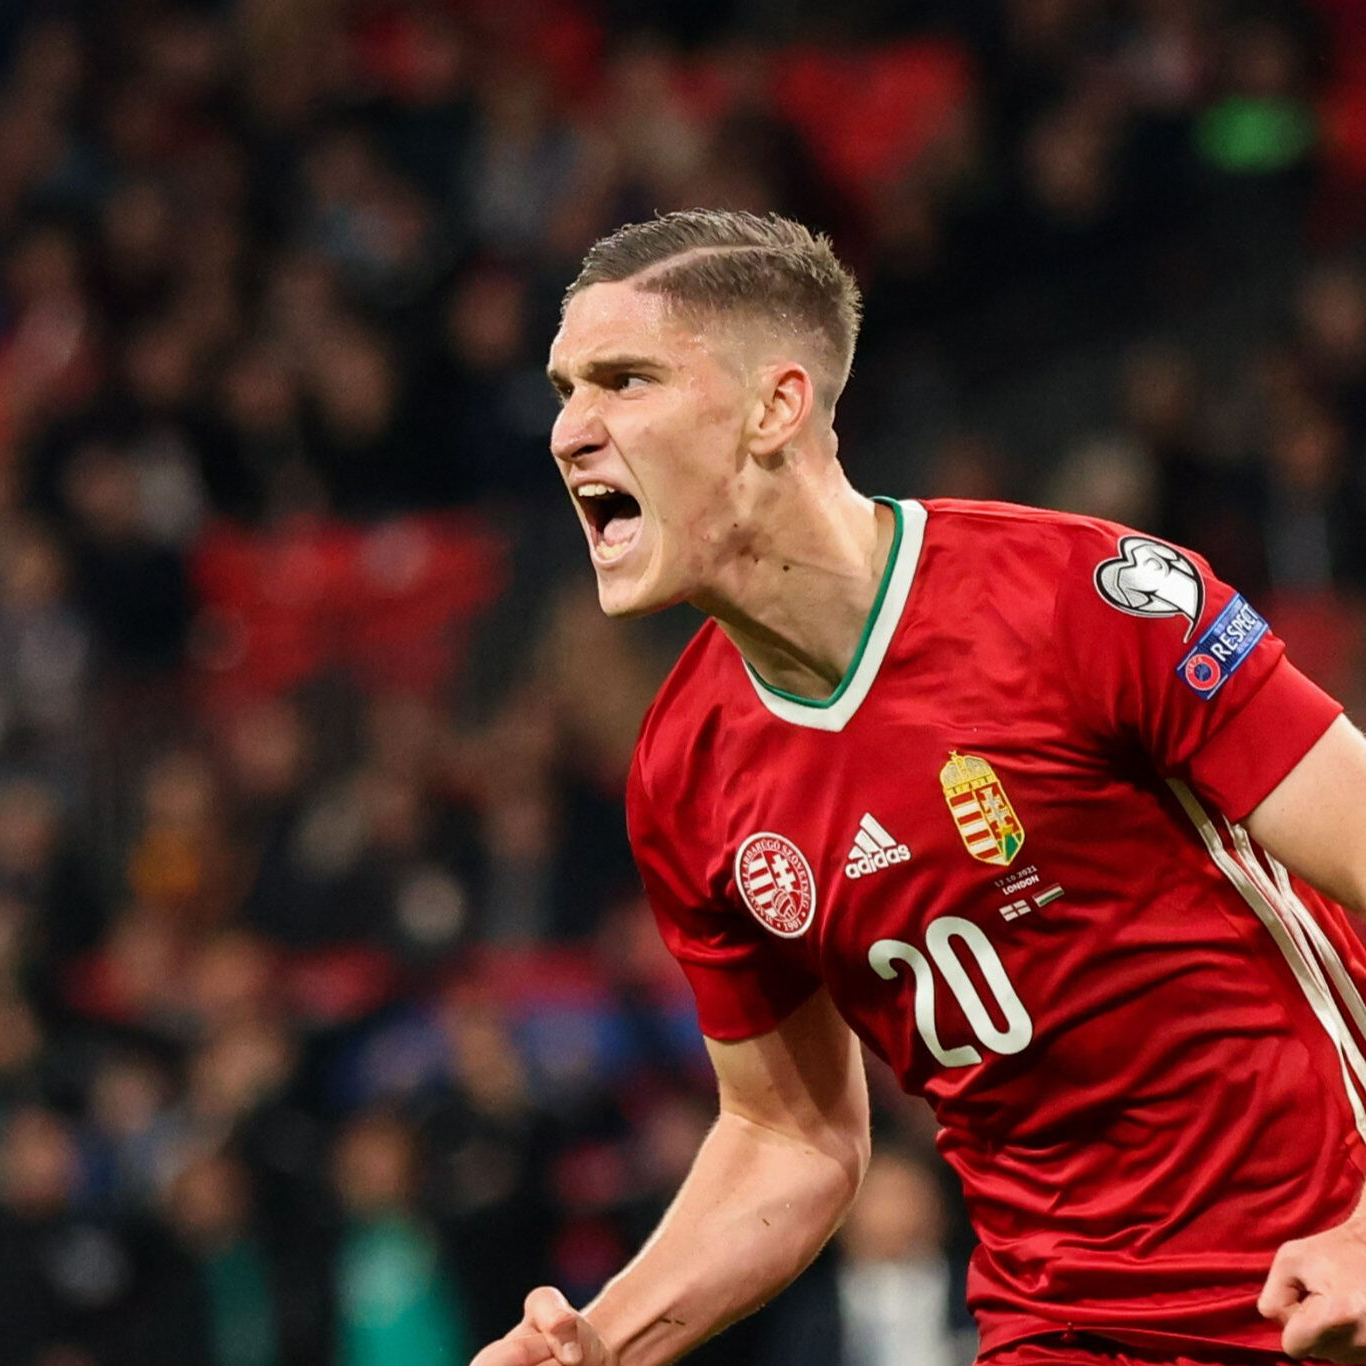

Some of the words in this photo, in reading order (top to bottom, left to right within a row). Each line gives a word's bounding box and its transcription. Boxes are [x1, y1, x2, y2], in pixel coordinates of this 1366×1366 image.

[1210, 603, 1259, 662] RESPECT
[845, 842, 911, 879] adidas
[1002, 874, 1040, 896] LONDON
[868, 916, 1033, 1068] 20
